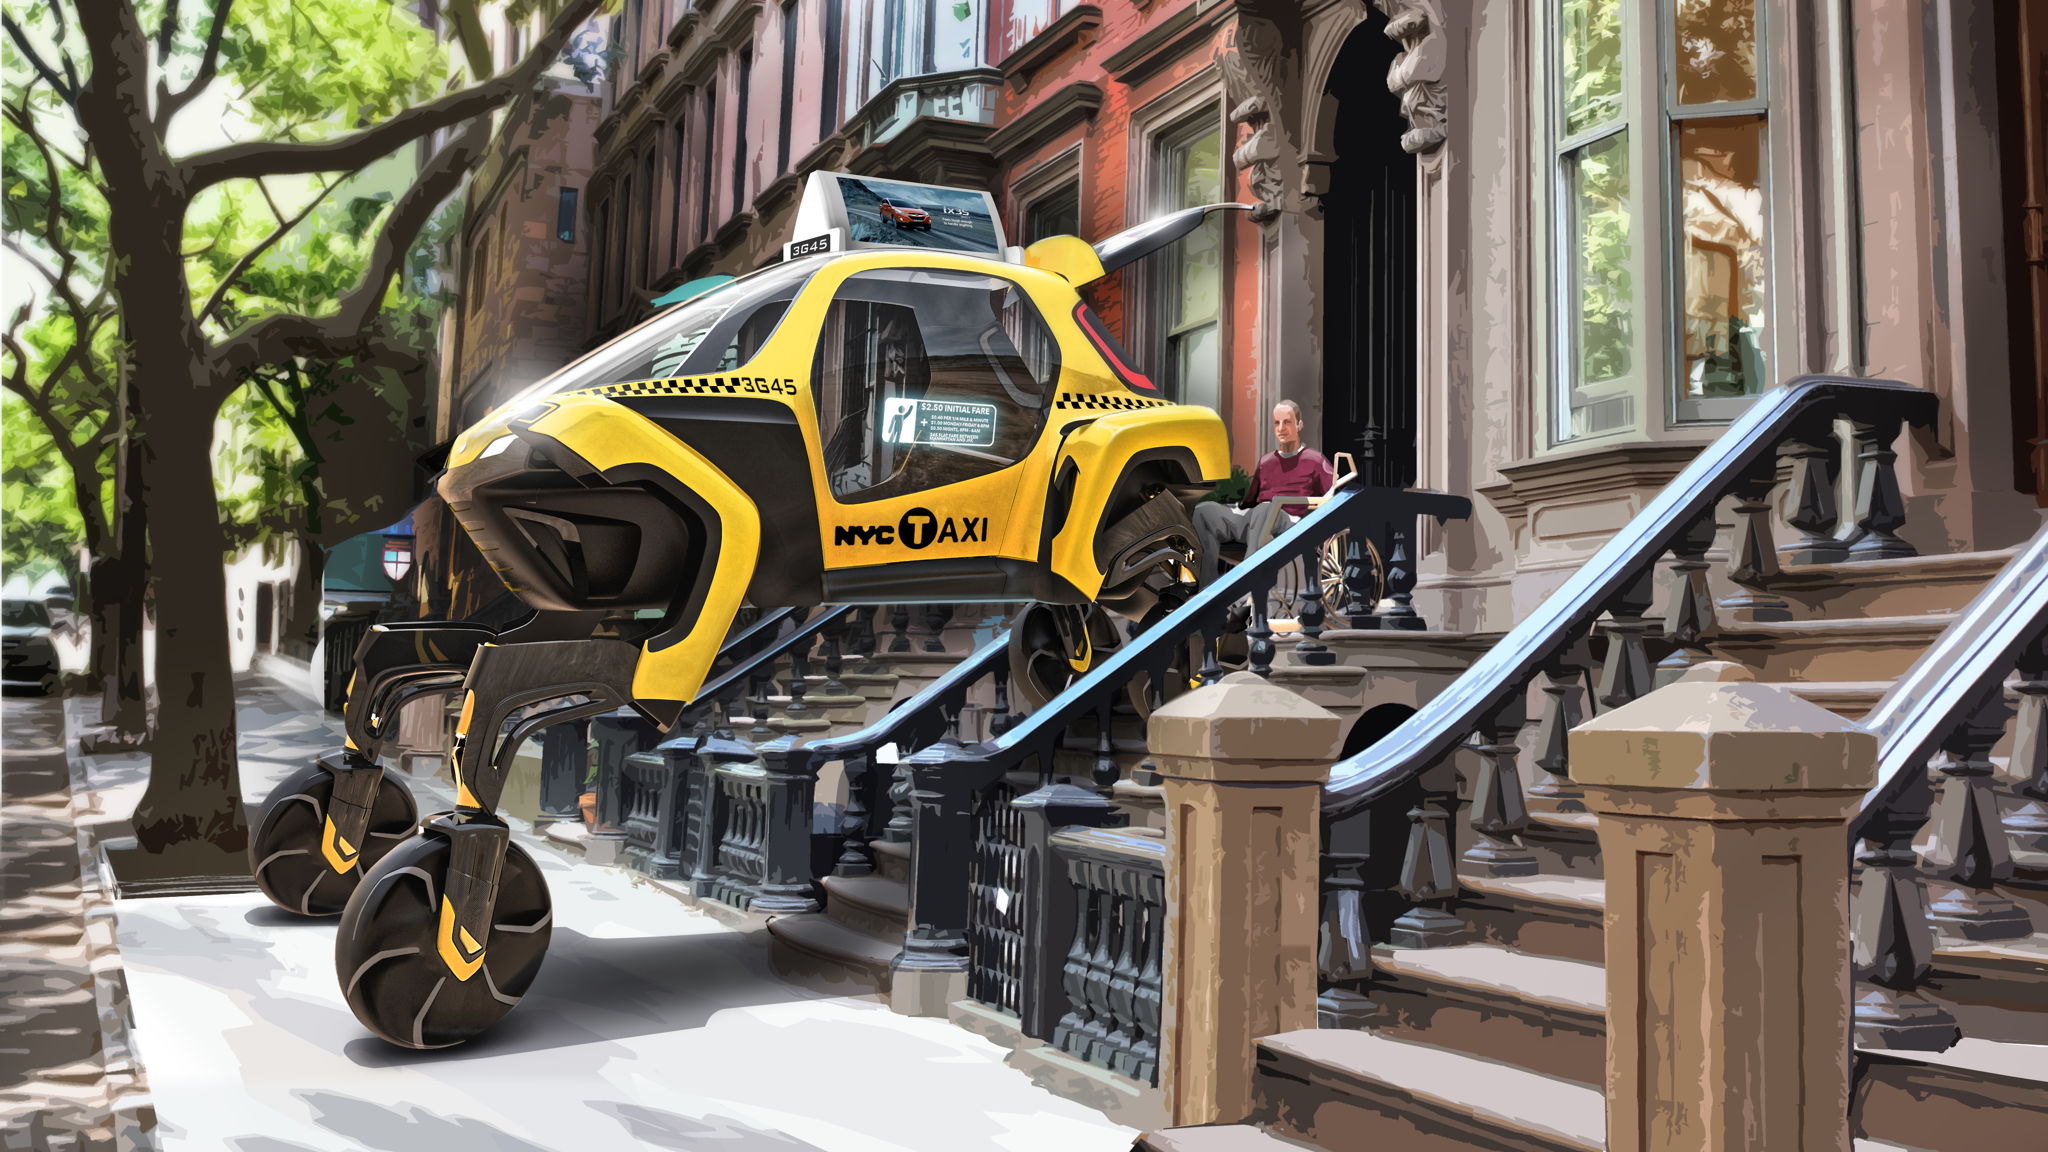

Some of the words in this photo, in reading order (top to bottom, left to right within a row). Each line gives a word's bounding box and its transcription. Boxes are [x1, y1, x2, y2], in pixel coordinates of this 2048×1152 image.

[793, 238, 828, 256] 3G45
[741, 377, 797, 395] 3G45
[921, 402, 943, 411] $2.50
[944, 404, 970, 414] INITIAL
[971, 407, 990, 415] FARE
[835, 525, 895, 546] NYC
[900, 509, 988, 548] TAXI
